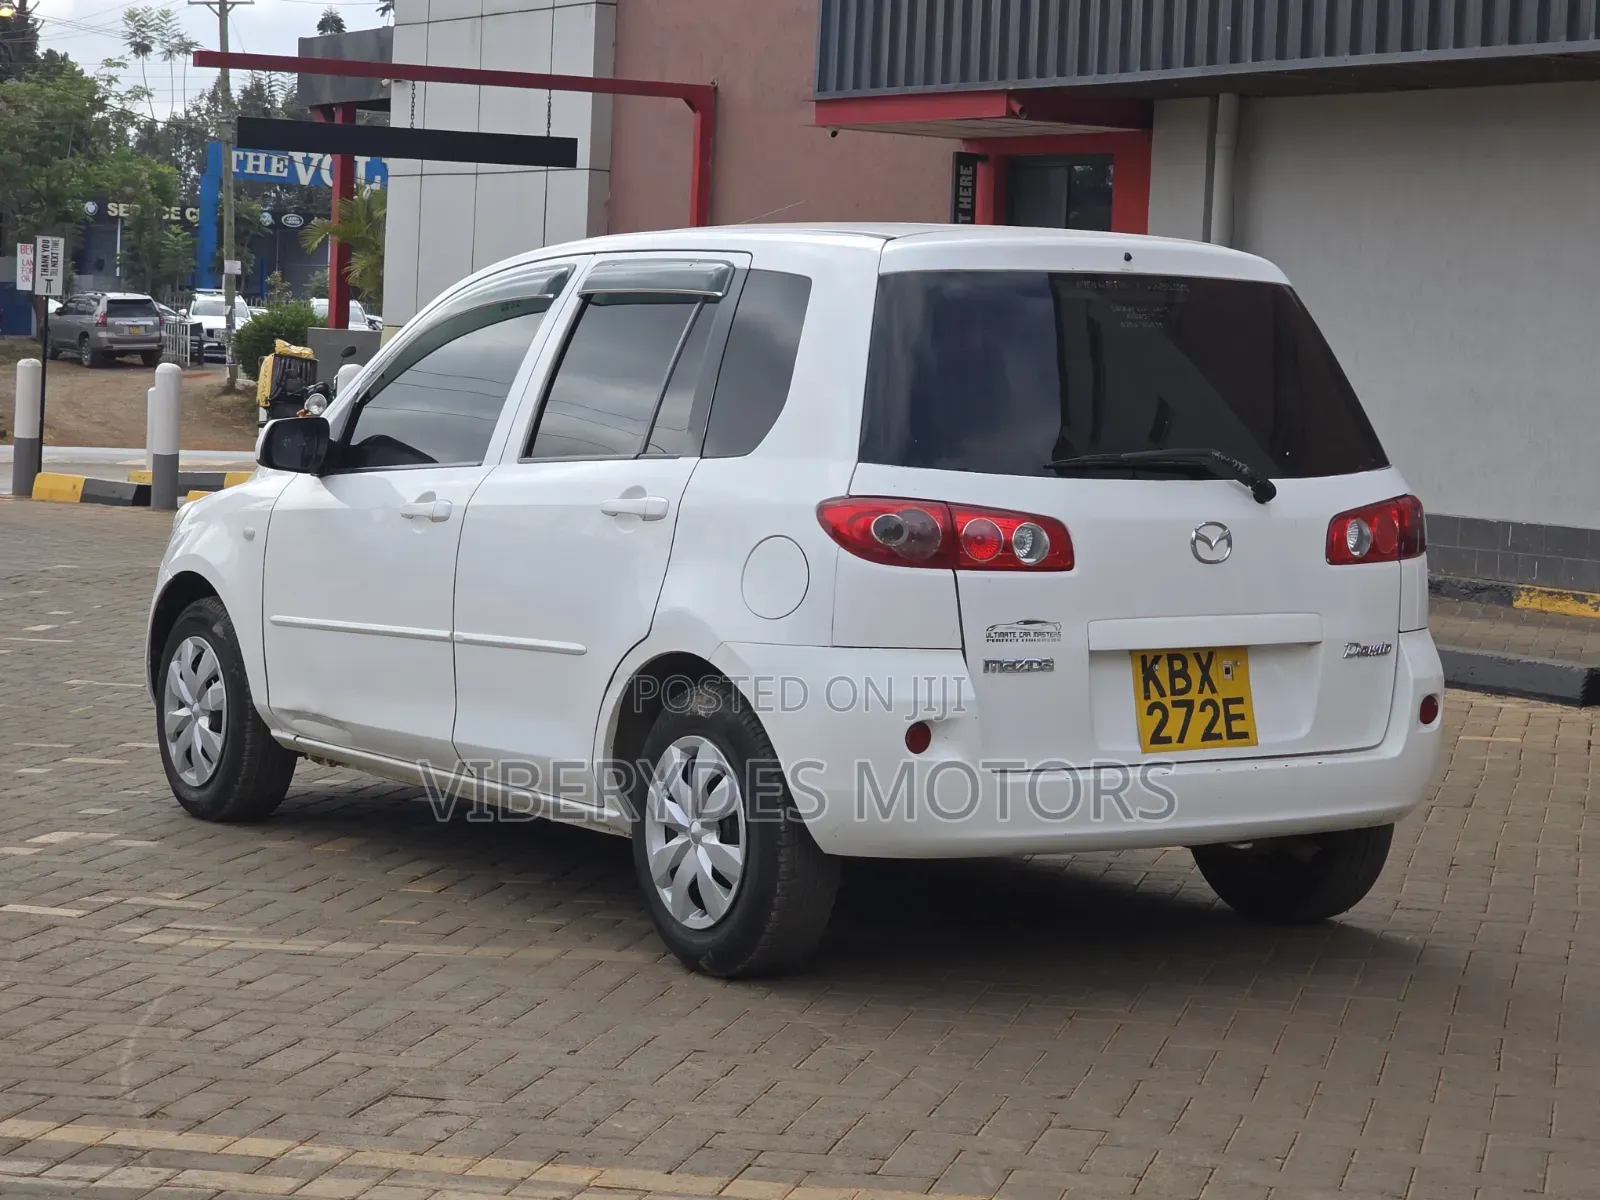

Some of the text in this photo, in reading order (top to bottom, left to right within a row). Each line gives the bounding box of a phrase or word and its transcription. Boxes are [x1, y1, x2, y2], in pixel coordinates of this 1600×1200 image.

[232, 150, 289, 178] THE
[959, 165, 973, 209] HERE
[41, 239, 50, 277] THANK YOU
[50, 252, 59, 268] NEXT
[986, 631, 1017, 639] ULTIMATE
[1141, 651, 1218, 700] KBX
[1146, 697, 1249, 745] 272E
